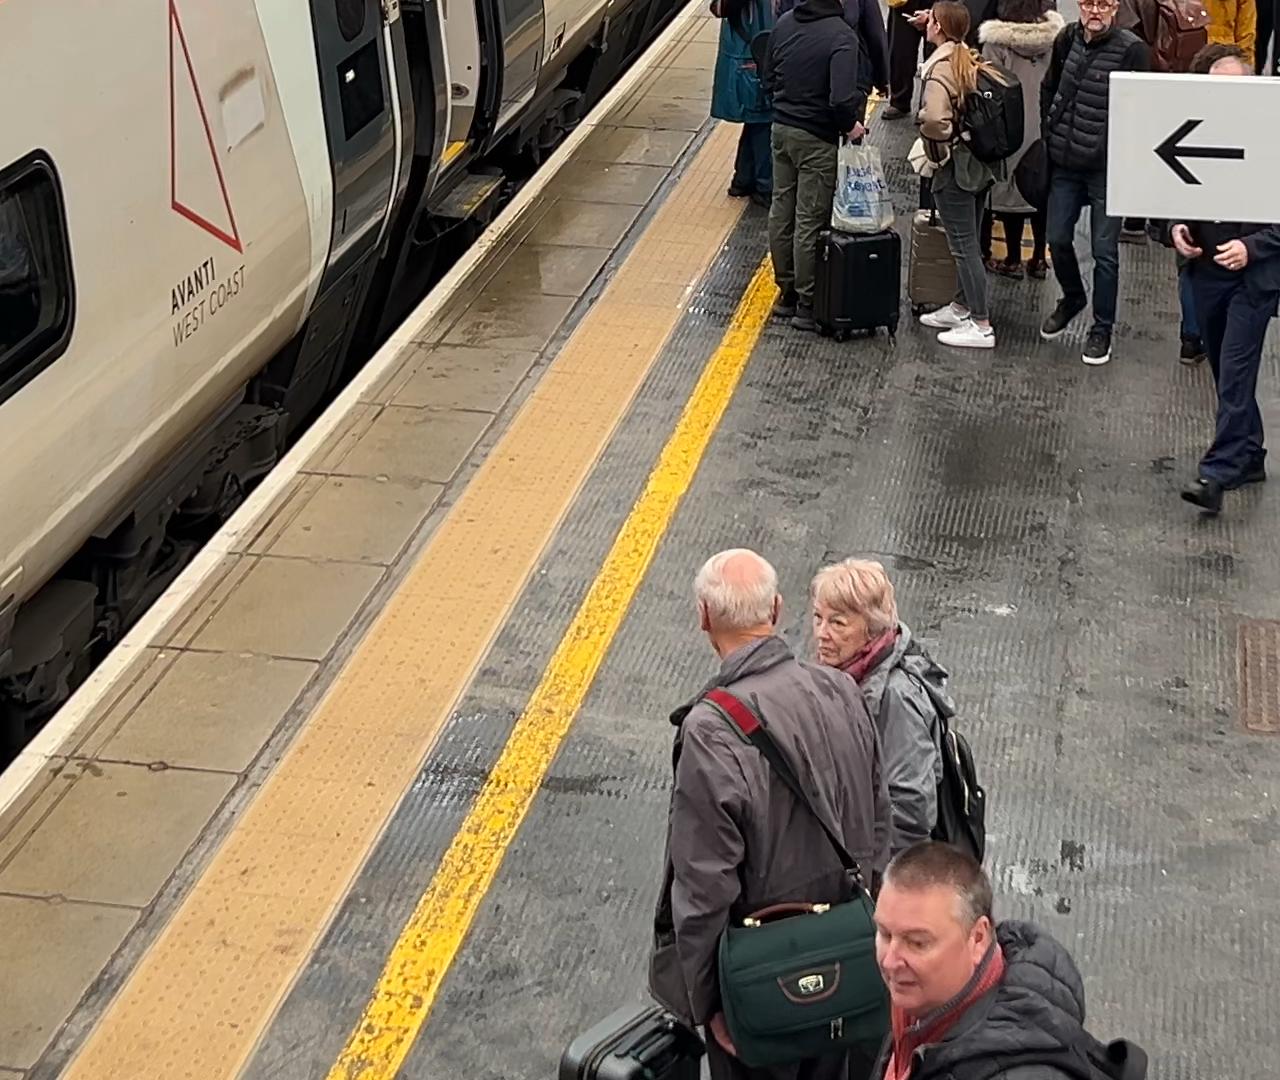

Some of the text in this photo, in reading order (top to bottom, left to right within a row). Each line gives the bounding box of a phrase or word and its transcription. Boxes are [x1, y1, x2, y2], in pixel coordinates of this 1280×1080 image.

[171, 256, 215, 316] AVANTI
[172, 264, 246, 348] WEST COAST
